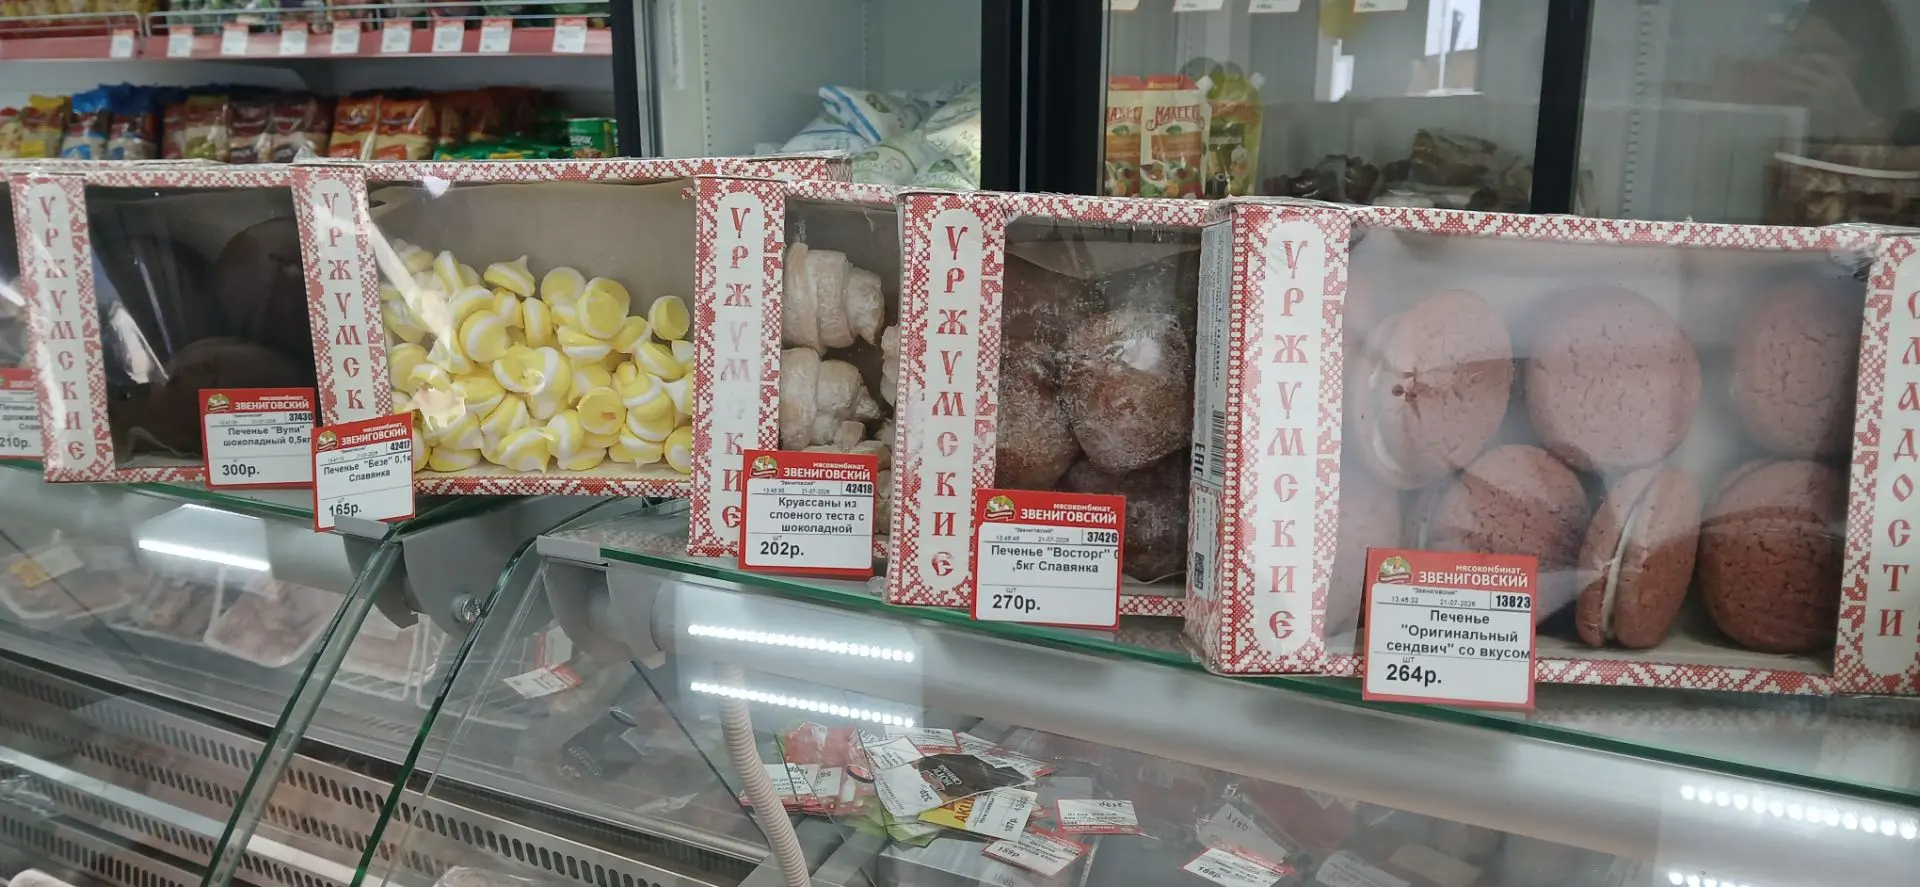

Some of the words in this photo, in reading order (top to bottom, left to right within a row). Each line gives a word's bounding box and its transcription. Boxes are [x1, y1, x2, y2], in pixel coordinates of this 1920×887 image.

[320, 192, 364, 410] УРЖУМСК
[720, 206, 753, 529] УРЖУМКИЕ
[234, 399, 309, 410] ЗВЕНИГОВСКИЙ
[930, 225, 968, 577] УРЖУМСКИЕ
[228, 427, 268, 435] Печенье
[341, 425, 407, 446] ЗВЕНИГОВСКИЙ
[223, 436, 286, 446] шоколадный
[390, 440, 410, 451] 42417
[1266, 239, 1309, 640] УРЖУМСКИЕ
[222, 464, 260, 477] 300р.
[323, 464, 360, 475] Печенье
[364, 457, 393, 468] "Безе"
[349, 469, 391, 482] Славянка
[783, 467, 871, 480] ЗВЕНИГОВСКИЙ
[845, 483, 873, 494] 42418
[329, 502, 362, 516] 165р.
[778, 497, 841, 508] Круассаны
[1053, 503, 1111, 512] мясокомбинат
[769, 511, 822, 520] слоеного
[825, 513, 855, 521] теста
[858, 513, 865, 521] с
[1020, 508, 1117, 524] ЗВЕНИГОВСКИЙ
[781, 523, 853, 535] шоколадной
[1087, 531, 1118, 543] 37426
[760, 541, 804, 559] 202р.
[991, 544, 1044, 557] Печенье
[1047, 546, 1111, 561] "Восторг"
[1012, 559, 1035, 572] ,5кг
[1038, 560, 1099, 573] Славянка
[1455, 565, 1522, 574] мясокомбинат
[1418, 571, 1528, 588] ЗВЕНИГОВСКИЙ
[992, 594, 1041, 613] 270р.
[1495, 594, 1531, 609] 13823
[1430, 609, 1490, 625] Печенье
[1401, 624, 1518, 642] "Оригинальный
[1386, 641, 1455, 656] сендвич"
[1458, 646, 1475, 656] со
[1480, 648, 1530, 661] вкусом
[1386, 664, 1442, 687] 264р.
